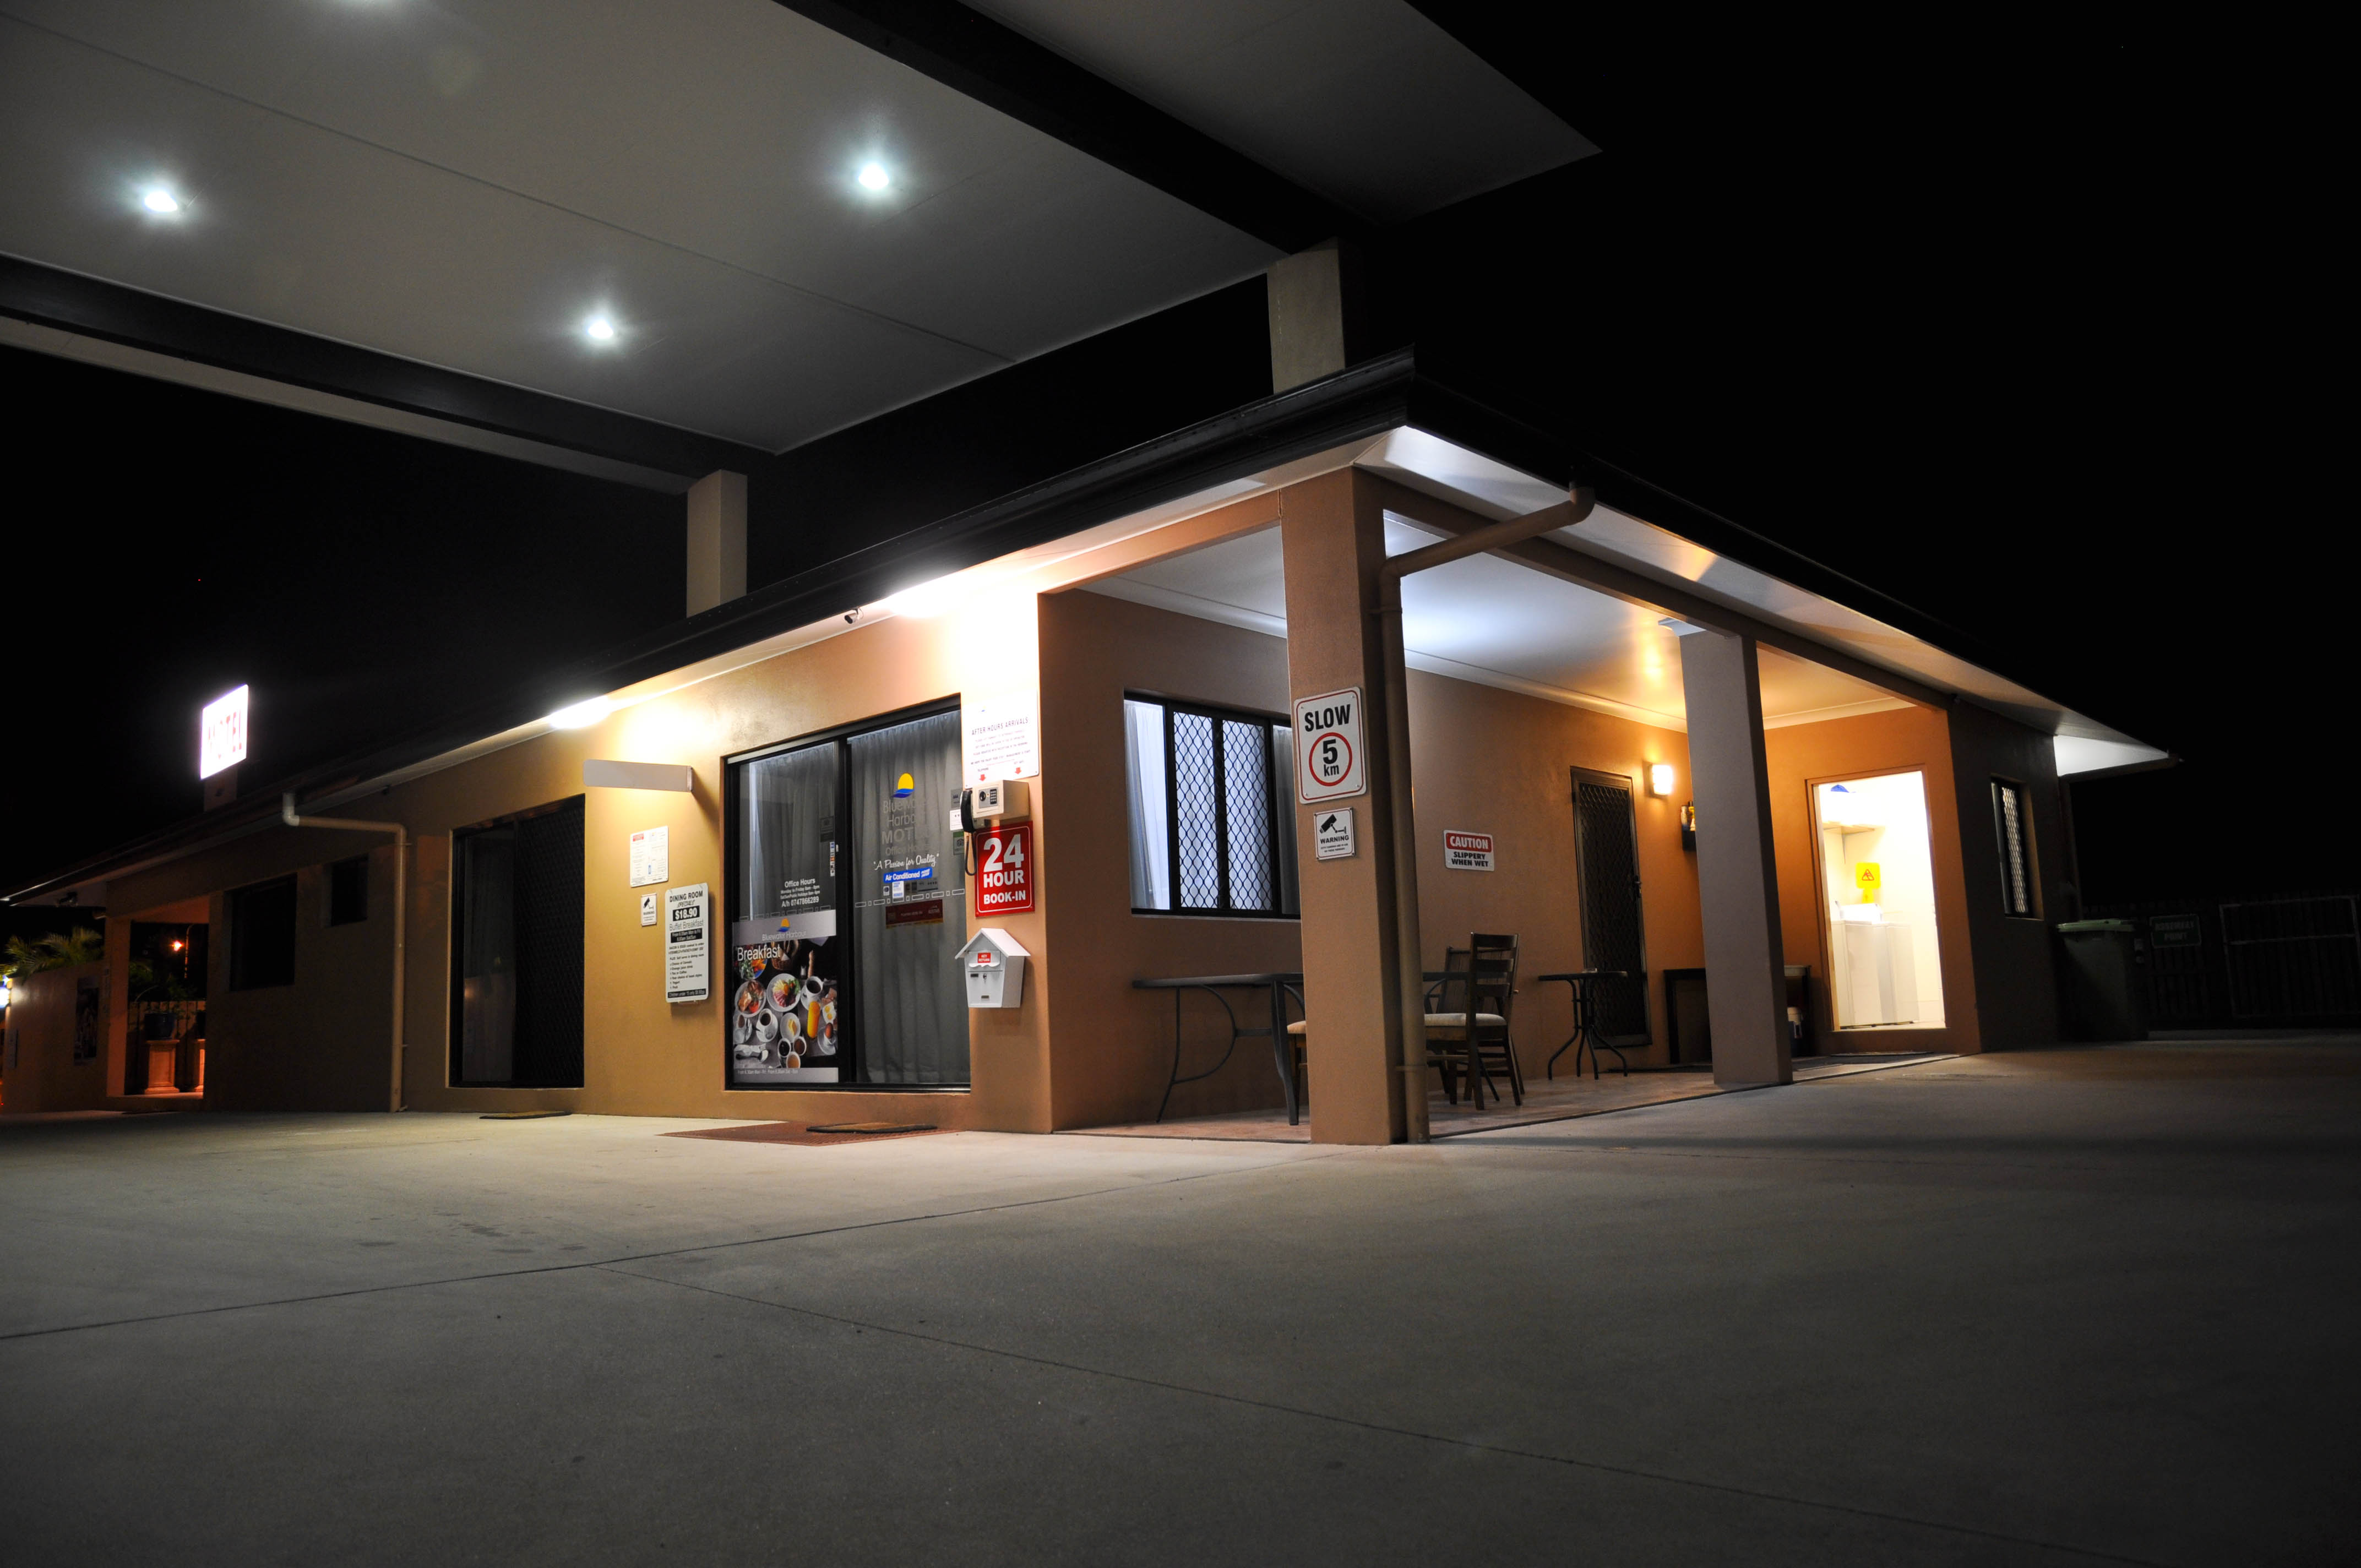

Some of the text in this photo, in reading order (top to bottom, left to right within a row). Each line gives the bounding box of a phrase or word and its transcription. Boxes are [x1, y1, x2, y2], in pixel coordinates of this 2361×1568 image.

[1304, 704, 1351, 732] SLOW
[971, 717, 1029, 736] AFTER HOURS ARRIVALS
[1323, 739, 1338, 765] 5
[1324, 764, 1340, 777] km
[1320, 835, 1349, 844] WARNING
[1450, 836, 1489, 850] CAUTION
[983, 834, 1024, 873] 24
[1454, 851, 1486, 860] SLIPPERY
[884, 859, 905, 869] Passion
[906, 857, 915, 870] for
[893, 871, 920, 880] Conditioned
[983, 869, 1025, 888] HOUR
[670, 890, 703, 902] DINING ROOM
[983, 890, 1026, 905] BOOK-IN
[675, 907, 698, 920] $18.90
[670, 918, 704, 931] Buffet Breakfast
[762, 930, 806, 941] Bluewater Harbour
[737, 944, 781, 961] Breakfast
